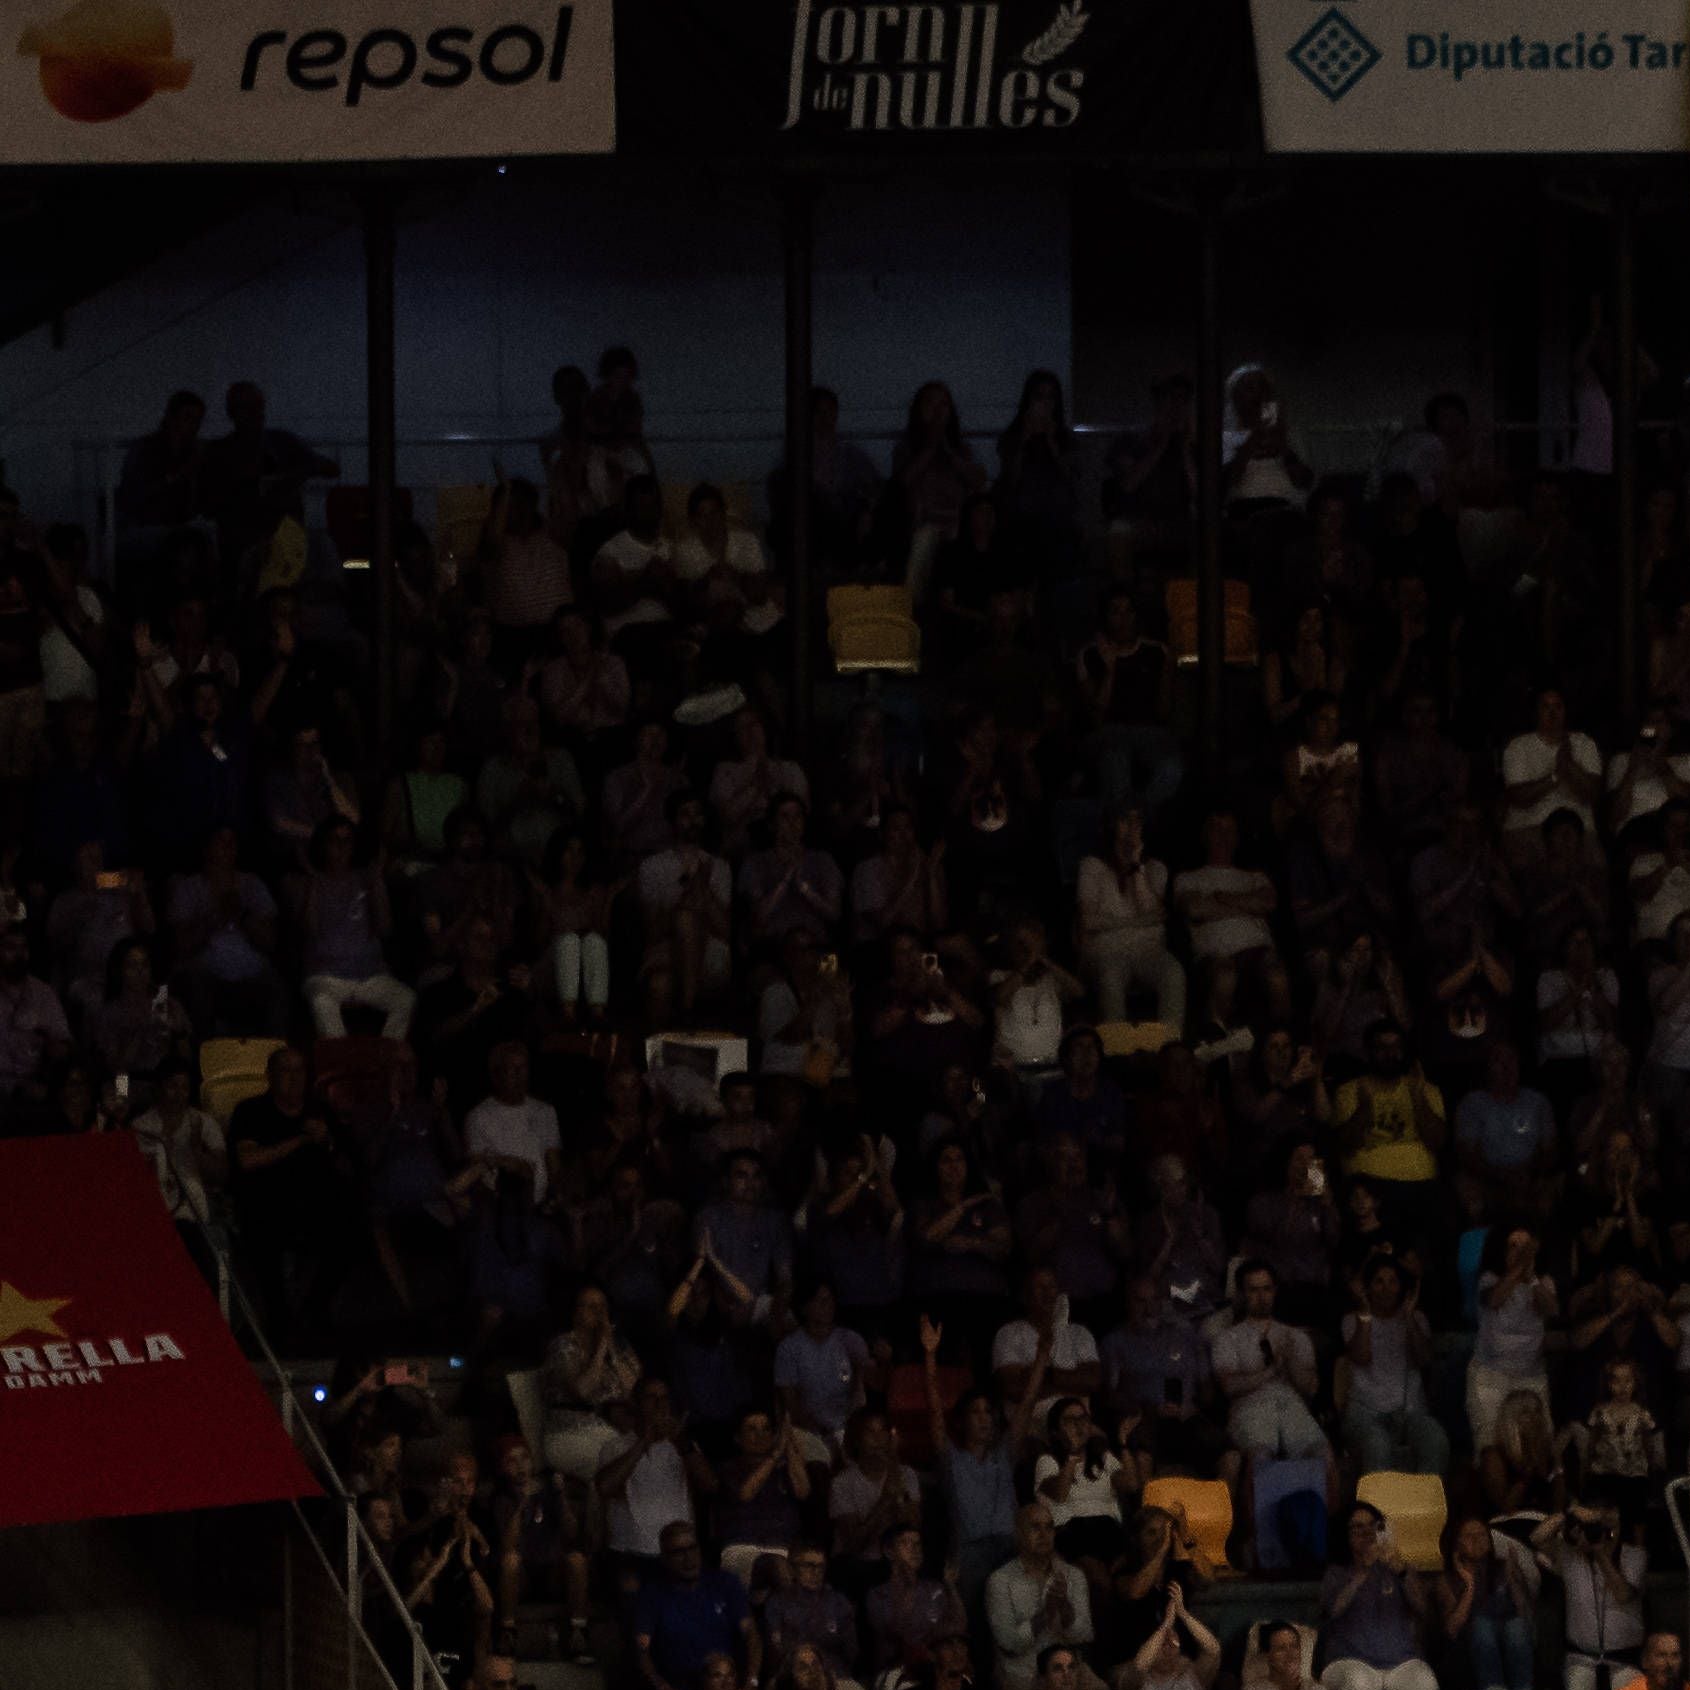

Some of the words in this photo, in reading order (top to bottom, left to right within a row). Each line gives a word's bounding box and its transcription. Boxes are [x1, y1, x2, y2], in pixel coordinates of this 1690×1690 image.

[239, 4, 574, 107] repsol
[1406, 31, 1613, 81] Diputació
[3, 1367, 104, 1390] DAMM
